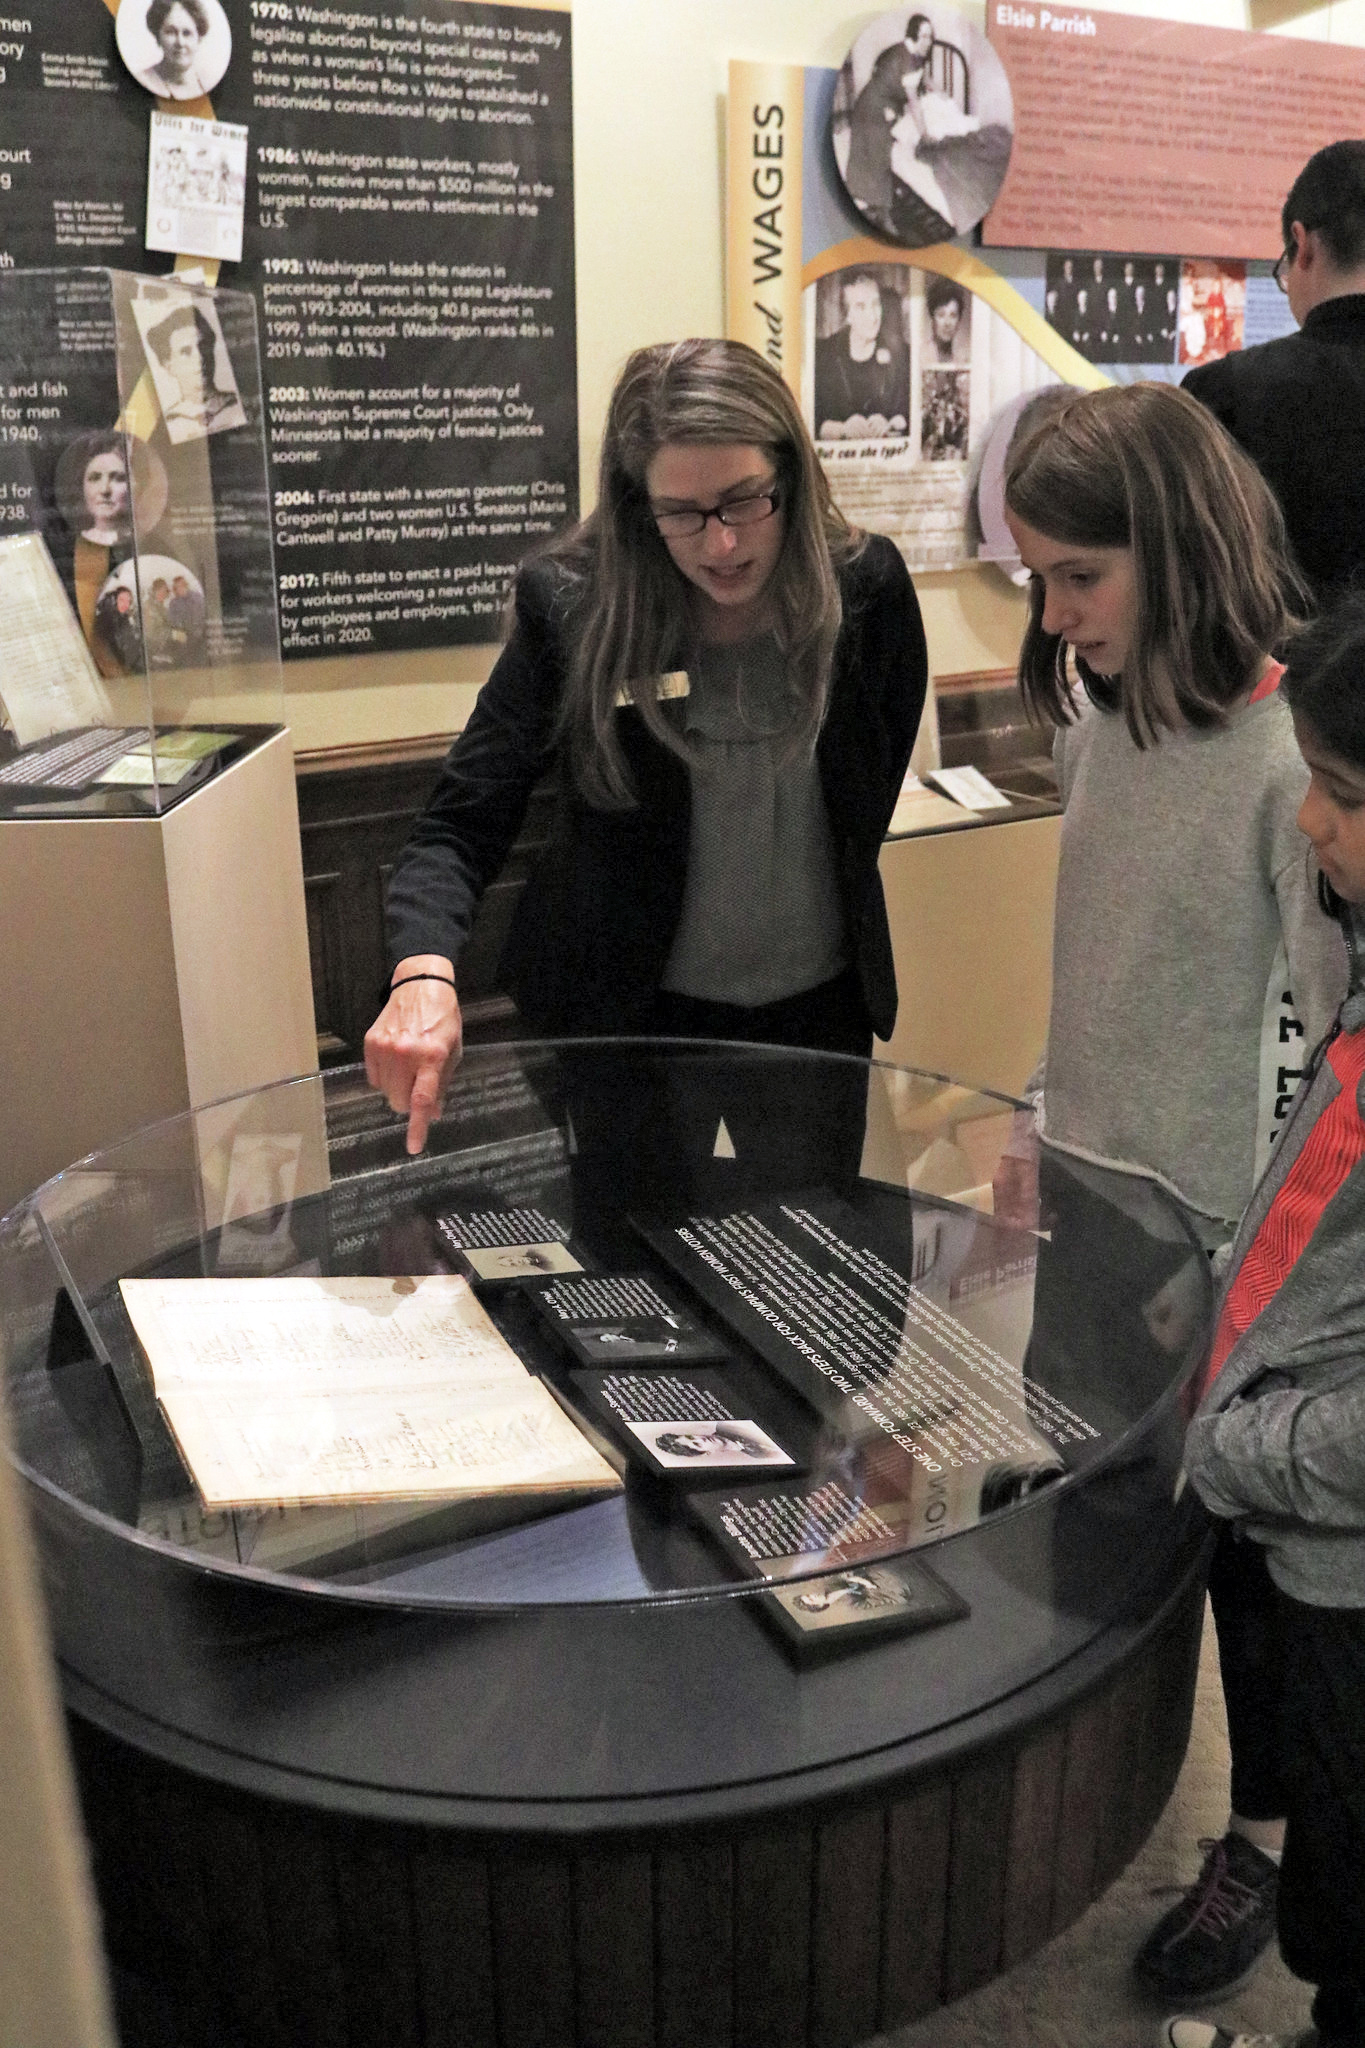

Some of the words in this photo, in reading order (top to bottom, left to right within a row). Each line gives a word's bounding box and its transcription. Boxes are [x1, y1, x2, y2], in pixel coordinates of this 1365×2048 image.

[253, 2, 293, 20] 1970:
[294, 5, 378, 29] Washington
[419, 16, 460, 34] fourth
[513, 26, 561, 48] broadly
[997, 4, 1036, 29] Elsie
[1040, 9, 1097, 38] Parrish
[249, 24, 304, 44] legalize
[307, 30, 366, 48] abortion
[369, 35, 421, 54] beyond
[424, 43, 469, 57] special
[509, 49, 539, 63] such
[270, 50, 309, 65] when
[252, 69, 290, 86] three
[292, 76, 330, 90] years
[332, 75, 378, 92] before
[381, 78, 408, 95] Roe
[424, 82, 462, 99] Wade
[253, 94, 331, 112] nationwide
[333, 100, 424, 117] constitutional
[426, 105, 458, 122] right
[256, 147, 299, 163] 1986:
[300, 149, 383, 170] Washington
[384, 155, 419, 170] state
[316, 174, 365, 188] receive
[368, 177, 403, 189] more
[405, 176, 435, 191] than
[438, 177, 471, 192] $500
[258, 191, 306, 210] largest
[308, 195, 389, 212] comparable
[391, 197, 430, 211] worth
[752, 103, 784, 285] WAGES
[259, 211, 287, 227] U.S.
[261, 258, 304, 274] 1993:
[305, 259, 386, 278] Washington
[388, 260, 424, 276] leads
[450, 263, 491, 277] nation
[262, 283, 340, 298] percentage
[361, 285, 409, 296] women
[485, 283, 553, 300] Legislature
[263, 300, 296, 315] from
[378, 303, 438, 319] including
[471, 306, 518, 319] percent
[307, 322, 338, 336] then
[401, 322, 481, 339] (Washington
[266, 342, 301, 357] 2019
[303, 343, 333, 357] with
[9, 381, 38, 398] and
[42, 380, 68, 398] fish
[268, 386, 310, 401] 2003:
[311, 385, 365, 400] Women
[367, 386, 419, 399] account
[421, 384, 440, 398] for
[453, 384, 504, 400] majority
[268, 407, 349, 424] Washington
[352, 405, 410, 422] Supreme
[412, 404, 449, 419] Court
[503, 402, 534, 419] Only
[270, 427, 341, 442] Minnesota
[382, 426, 435, 441] majority
[453, 423, 497, 436] female
[498, 424, 544, 438] justices
[271, 450, 320, 463] sooner.
[11, 482, 32, 499] for
[273, 490, 315, 506] 2004:
[317, 489, 346, 503] First
[348, 488, 382, 502] state
[383, 486, 411, 500] with
[423, 486, 470, 499] woman
[472, 484, 528, 500] governor
[530, 480, 565, 494] (Chris
[274, 509, 338, 527] Gregoire)
[369, 509, 394, 520] two
[396, 507, 443, 519] women
[445, 502, 472, 517] U.S.
[474, 502, 526, 515] Senators
[275, 529, 334, 545] Cantwell
[365, 526, 398, 542] Patty
[400, 523, 449, 539] Murray)
[278, 572, 319, 589] 2017:
[321, 570, 352, 585] Fifth
[353, 570, 386, 584] state
[405, 566, 440, 580] enact
[453, 562, 482, 580] paid
[279, 595, 299, 608] for
[301, 592, 353, 606] workers
[355, 588, 424, 603] welcoming
[281, 614, 298, 630] by
[301, 611, 372, 627] employees
[401, 604, 470, 620] employers,
[282, 632, 320, 647] effect
[338, 627, 373, 642] 2020.
[673, 1226, 706, 1250] VOTERS
[695, 1247, 731, 1274] WOMEN
[720, 1272, 747, 1290] FIRST
[557, 1309, 571, 1319] Mary
[736, 1287, 781, 1322] OLYMPIA'S
[770, 1319, 796, 1336] FOR
[786, 1334, 817, 1355] BACK
[805, 1352, 839, 1376] STEPS
[827, 1373, 858, 1393] TWO
[846, 1391, 903, 1434] FORWARD,
[889, 1431, 923, 1453] STEP
[910, 1451, 944, 1472] ONE
